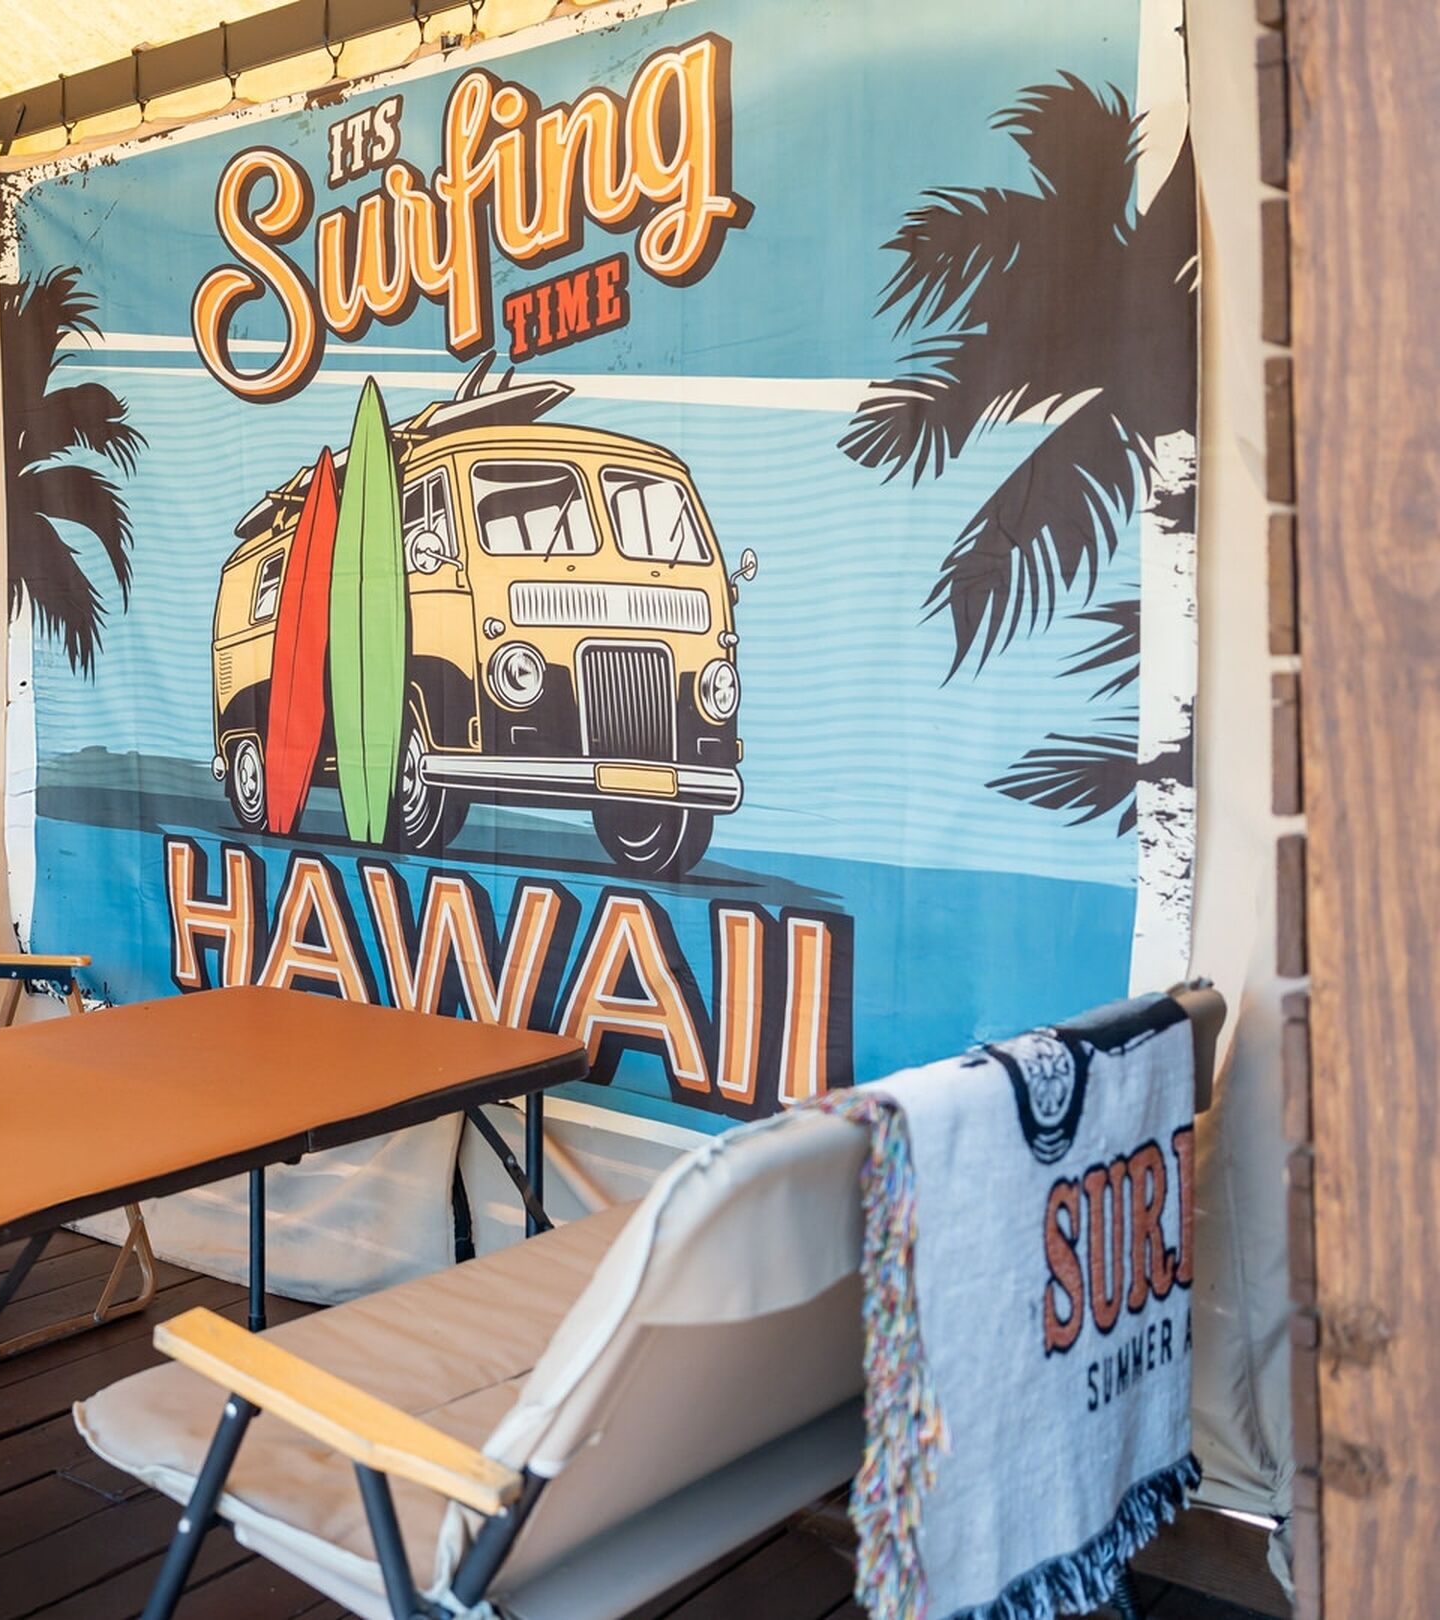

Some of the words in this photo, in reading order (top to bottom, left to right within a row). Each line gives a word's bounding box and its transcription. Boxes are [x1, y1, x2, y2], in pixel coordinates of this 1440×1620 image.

[328, 95, 403, 190] ITS
[191, 32, 755, 403] Surfing
[503, 252, 629, 363] TIME
[164, 834, 853, 1120] HAWAII
[1087, 1318, 1172, 1411] SUMMER
